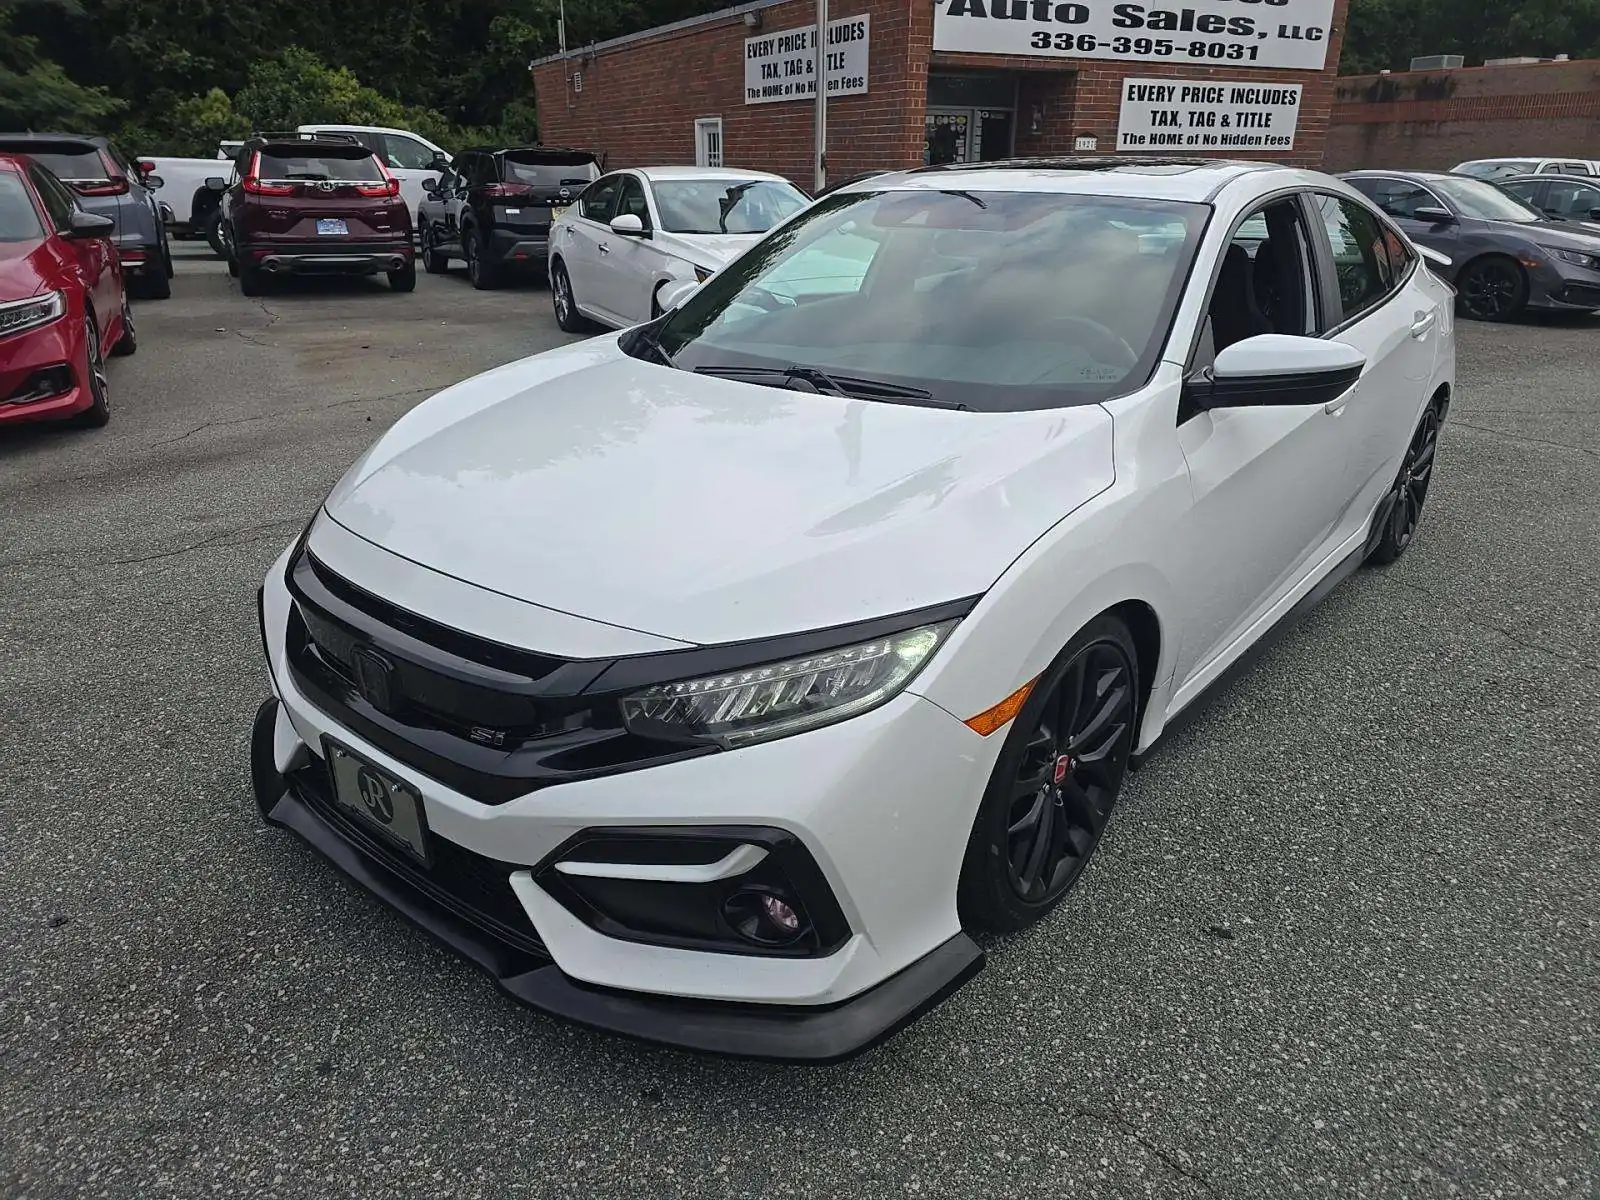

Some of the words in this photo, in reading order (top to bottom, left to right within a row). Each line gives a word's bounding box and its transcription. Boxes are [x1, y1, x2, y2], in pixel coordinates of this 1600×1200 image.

[946, 0, 1090, 24] Auto
[1112, 3, 1268, 40] Sales,
[1277, 24, 1323, 41] LLC
[747, 39, 775, 59] EVERY
[778, 32, 806, 54] PRICE
[811, 21, 865, 49] ILUDES
[1030, 31, 1259, 61] 336-395-8031
[761, 62, 781, 80] TAX,
[784, 58, 803, 77] TAG
[806, 59, 813, 74] &
[747, 87, 760, 99] The
[762, 84, 783, 98] HOME
[784, 83, 793, 95] of
[795, 82, 806, 94] No
[807, 78, 839, 93] Hien
[841, 76, 864, 89] Fees
[1127, 84, 1176, 102] EVERY
[1181, 86, 1225, 104] PRICE
[1230, 87, 1298, 106] INCLUDES
[1150, 110, 1183, 129] TAX,
[1188, 111, 1216, 128] TAG
[1220, 114, 1231, 128] &
[1236, 112, 1273, 128] TITLE
[1122, 132, 1146, 145] The
[1149, 133, 1184, 145] HOME
[1187, 133, 1200, 145] of
[1203, 134, 1218, 146] No
[1220, 133, 1262, 146] Hidden
[1264, 134, 1291, 146] Fees
